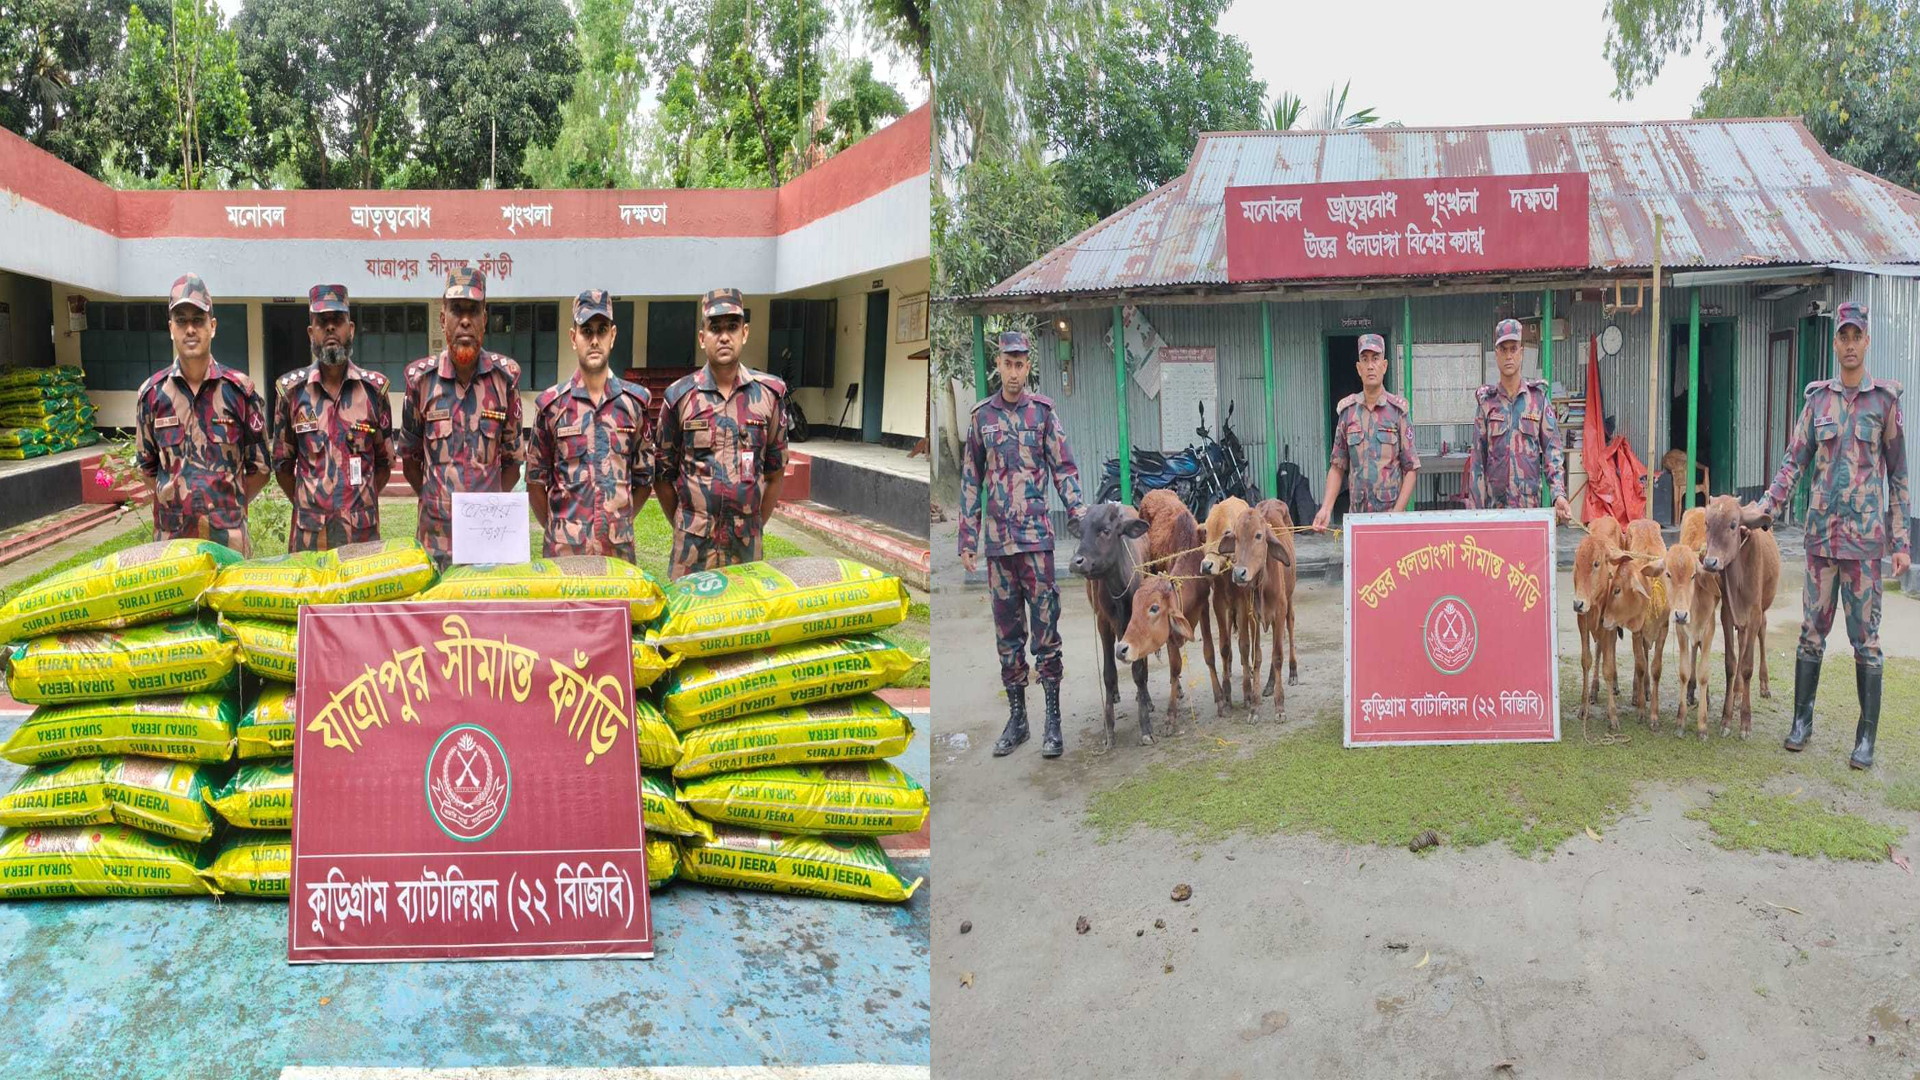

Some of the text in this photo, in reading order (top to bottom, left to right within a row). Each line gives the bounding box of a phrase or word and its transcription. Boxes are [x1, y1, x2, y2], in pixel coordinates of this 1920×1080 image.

[1240, 184, 1559, 230] মনোবল ভ্রাতৃত্ববোধ শৃংখলা দক্ষতা
[225, 202, 668, 237] মনোবল ভ্রাতৃত্ববোধ শৃংখলা দক্ষতা
[1304, 228, 1338, 258] উত্তর
[1346, 231, 1401, 257] ধলডাঙ্গা
[1405, 222, 1446, 255] বিশেষ
[365, 259, 419, 281] যাত্রাপুর
[1358, 535, 1541, 612] উত্তর ধলডাংগা সীমান্ত ফাঁড়ি
[118, 587, 184, 610] SURAJ JEERA
[243, 597, 276, 608] SURAJ
[339, 583, 404, 604] SURAJ JEERA
[22, 607, 89, 632] SURAJ JEERA
[802, 613, 874, 635] SURAJ JEERA
[700, 630, 772, 651] SURAJ JEERA
[250, 654, 284, 671] SURAJ
[38, 679, 114, 695] SURAJ JEERA
[128, 668, 207, 689] SURAJ JEERA
[790, 678, 868, 700] SURAJ JEERA
[306, 615, 628, 765] যাত্রাপুর সীমান্ত ফাঁড়ি
[699, 696, 775, 724] SURAJ JEERA
[1360, 690, 1545, 724] কুড়িগ্রাম ব্যাটালিয়ন (২২ বিজিবি)
[37, 723, 102, 741] SURAJ JEERA
[132, 723, 198, 736] SURAJ JEERA
[808, 726, 877, 742] SURAJ JEERA
[130, 743, 196, 754] SURAJ JEERA
[709, 734, 778, 753] SURAJ JEERA
[806, 745, 876, 758] SURAJ JEERA
[708, 753, 776, 769] SURAJ JEERA
[51, 791, 88, 807] JEERA
[134, 794, 170, 812] JEERA
[726, 806, 795, 822] SURAJ JEERA
[825, 813, 893, 826] SURAJ JEERA
[4, 863, 72, 878] SURAJ JEERA
[103, 864, 171, 879] SURAJ JEERA
[698, 851, 777, 873] SURAJ JEERA
[250, 879, 286, 891] JEERA
[791, 862, 872, 888] SURAJ JEERA
[306, 861, 635, 938] কুড়িগ্রাম ব্যাটালিয়ন (২২ বিজিবি)
